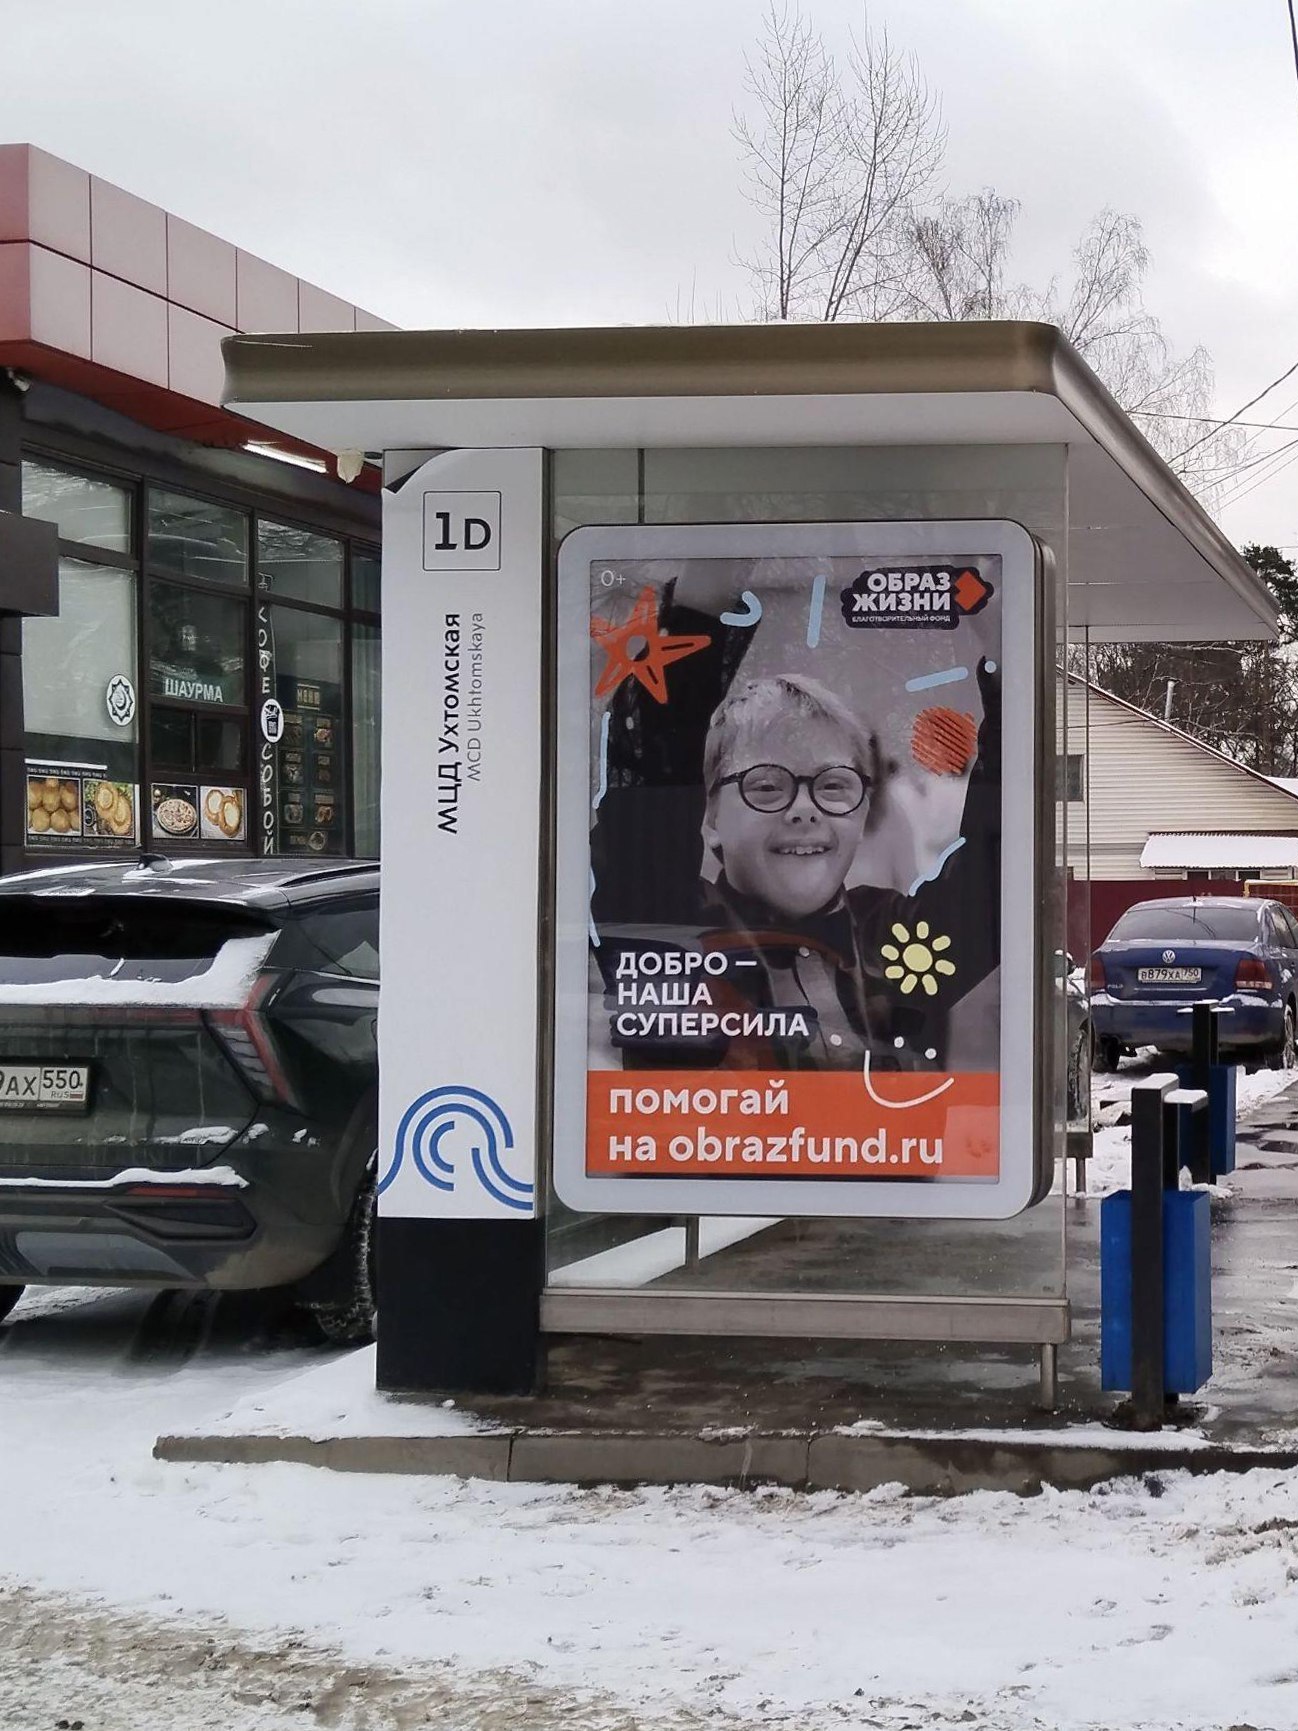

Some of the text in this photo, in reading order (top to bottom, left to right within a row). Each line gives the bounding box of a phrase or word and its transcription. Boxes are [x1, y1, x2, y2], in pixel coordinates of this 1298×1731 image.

[434, 511, 492, 550] 1D
[601, 570, 626, 587] 0+
[867, 572, 951, 592] ОБРАЗ
[852, 592, 951, 612] ЖИЗНИ
[852, 614, 951, 623] БЛАГОТВОРИТЕЛЬНЫЙ ФОНД
[165, 678, 224, 703] ШАУРМА
[467, 612, 486, 782] MCD Ukhtomskaya
[437, 614, 463, 835] МЦД Ухтомская
[616, 952, 729, 977] ДОБРО
[618, 982, 713, 1006] НАША
[616, 1012, 810, 1037] СУПЕРСИЛА
[42, 1069, 81, 1089] 550
[609, 1078, 789, 1115] помогай
[609, 1127, 944, 1164] на obrazfund.ru
